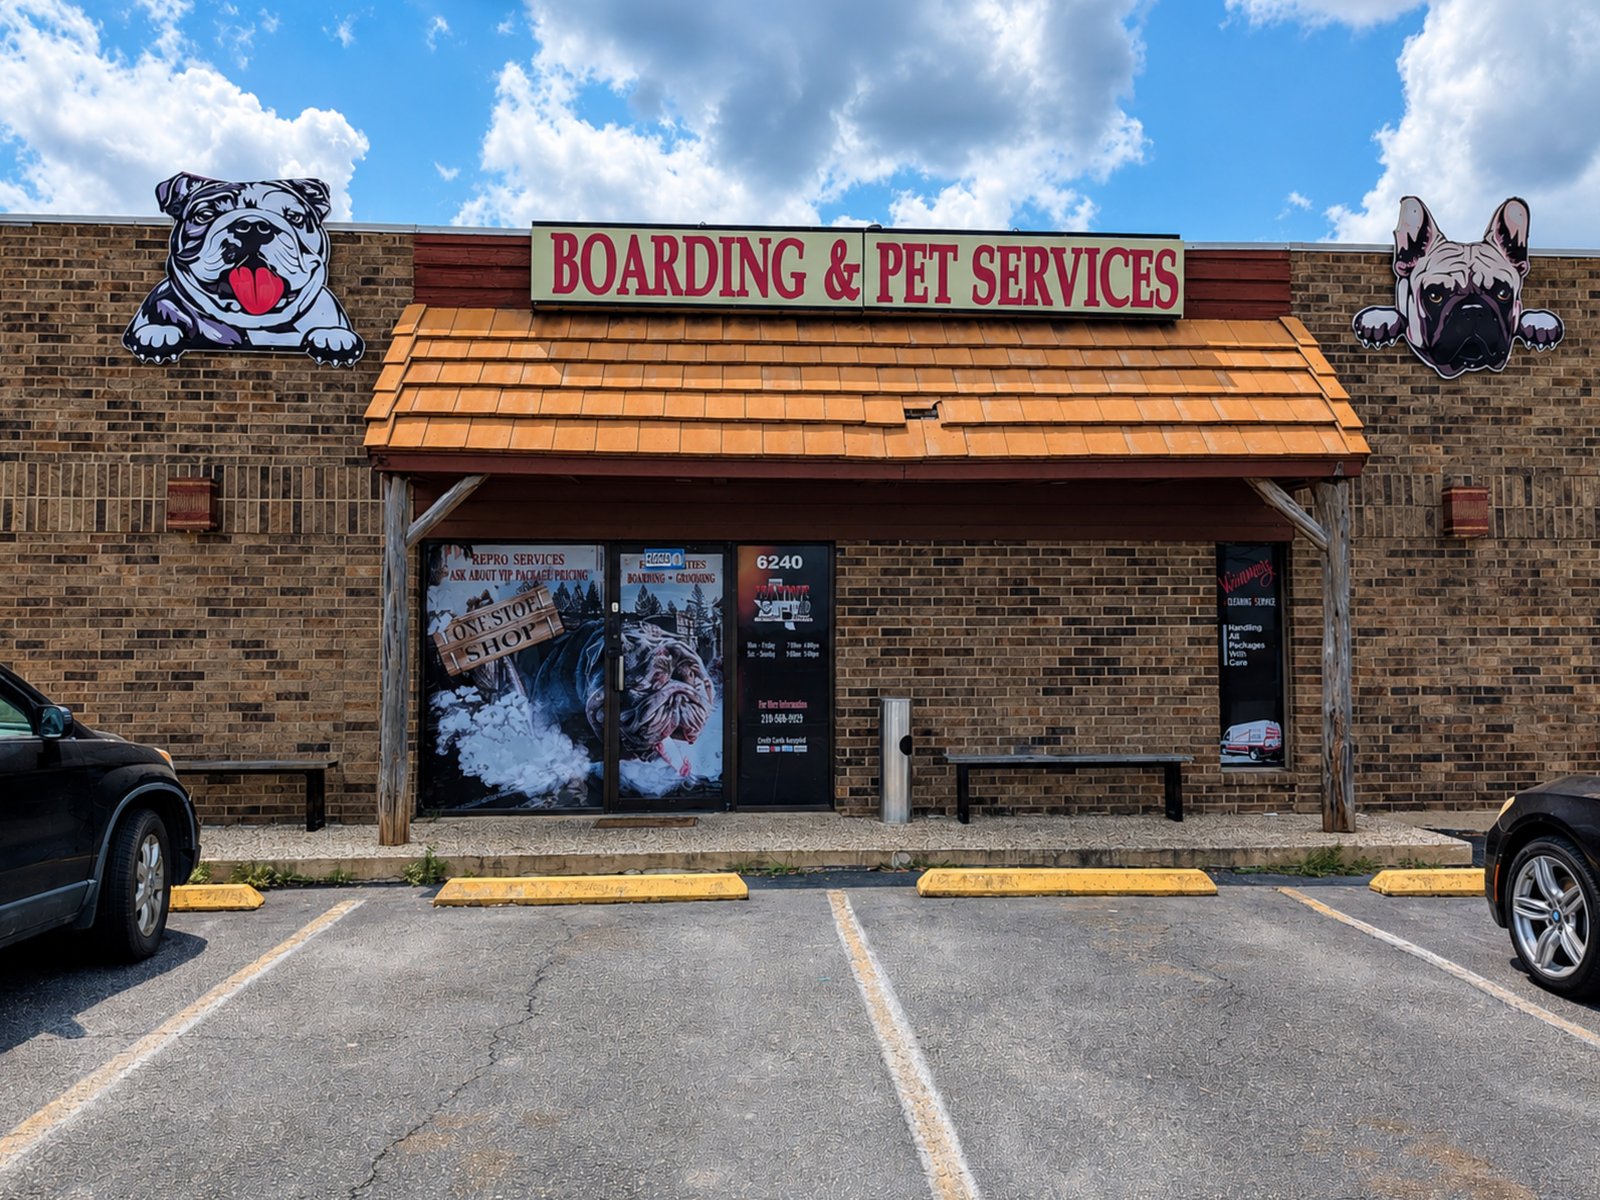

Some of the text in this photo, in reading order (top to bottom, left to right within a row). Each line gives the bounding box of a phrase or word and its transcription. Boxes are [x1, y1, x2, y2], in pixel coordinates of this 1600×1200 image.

[551, 232, 1179, 310] BOARDING & PET SERVICES
[472, 553, 565, 566] REPRO SERVICES
[756, 555, 803, 569] 6240
[449, 569, 589, 582] ASK ABOUT VIP PACKAGE PRICING
[627, 573, 716, 584] BOARDING GROOMING
[452, 613, 490, 642] ONE
[1228, 624, 1263, 632] Handling
[464, 622, 537, 664] SHOP
[1228, 641, 1266, 650] Packages
[1228, 659, 1248, 667] Care
